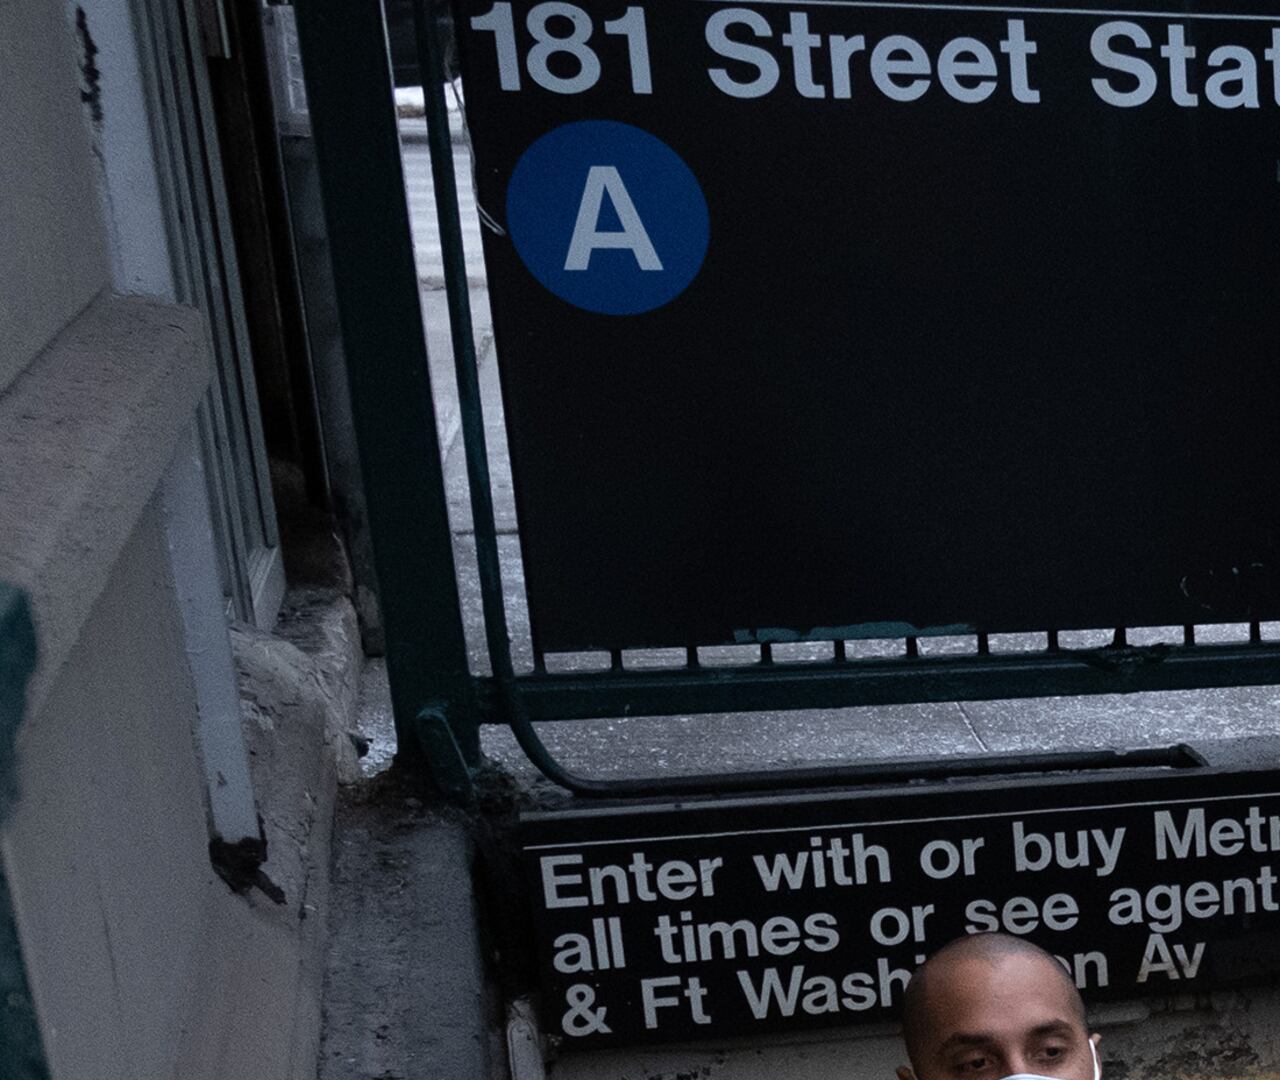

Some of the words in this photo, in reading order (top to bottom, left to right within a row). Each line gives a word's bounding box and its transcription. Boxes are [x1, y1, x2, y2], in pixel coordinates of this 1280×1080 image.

[470, 1, 653, 94] 181
[705, 8, 1041, 104] Street
[563, 165, 664, 272] A
[540, 852, 724, 909] Enter
[752, 833, 892, 892] with
[920, 837, 986, 879] or
[1012, 821, 1126, 877] buy
[553, 917, 627, 973] all
[654, 910, 841, 964] times
[870, 904, 936, 946] or
[965, 893, 1080, 934] see
[1108, 866, 1279, 933] agent
[562, 984, 613, 1036] &
[641, 975, 711, 1029] Ft
[1138, 933, 1206, 982] Av
